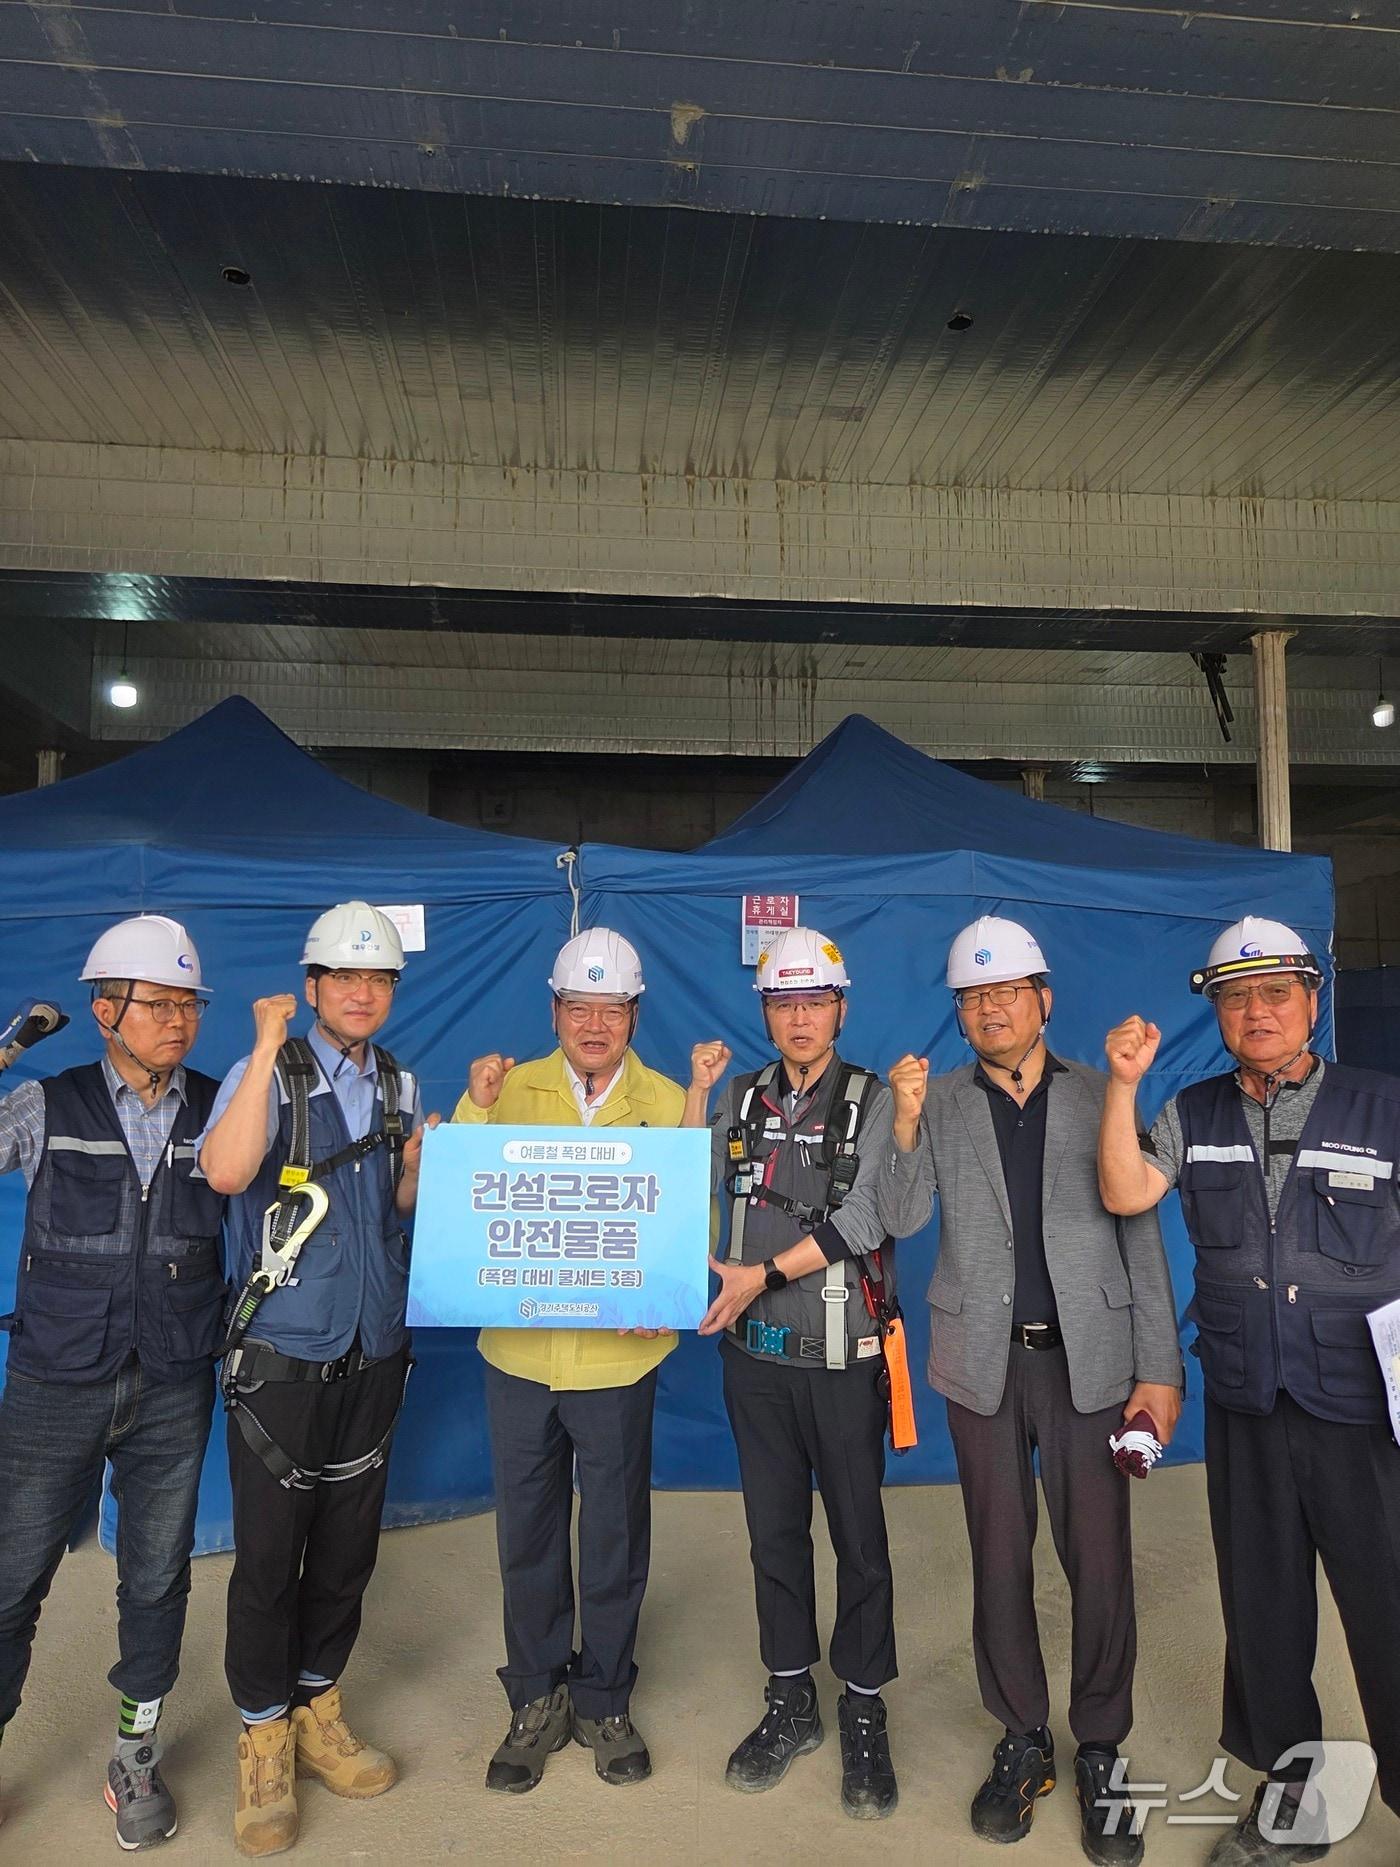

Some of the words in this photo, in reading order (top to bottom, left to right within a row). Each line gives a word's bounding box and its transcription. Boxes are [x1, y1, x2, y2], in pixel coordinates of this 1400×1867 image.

[752, 895, 789, 906] 근로자
[752, 905, 789, 916] 휴게실
[1322, 1141, 1339, 1149] MOO
[520, 1145, 558, 1159] 여름철
[562, 1145, 587, 1160] 폭염
[590, 1146, 615, 1161] 대비
[472, 1172, 660, 1213] 건설근로자
[488, 1219, 637, 1260] 안전물품
[478, 1269, 517, 1286] (폭염
[521, 1269, 553, 1286] 대비
[558, 1269, 606, 1287] 쿨세트
[610, 1270, 643, 1288] 3종)
[540, 1303, 597, 1312] 경기주택도시공사
